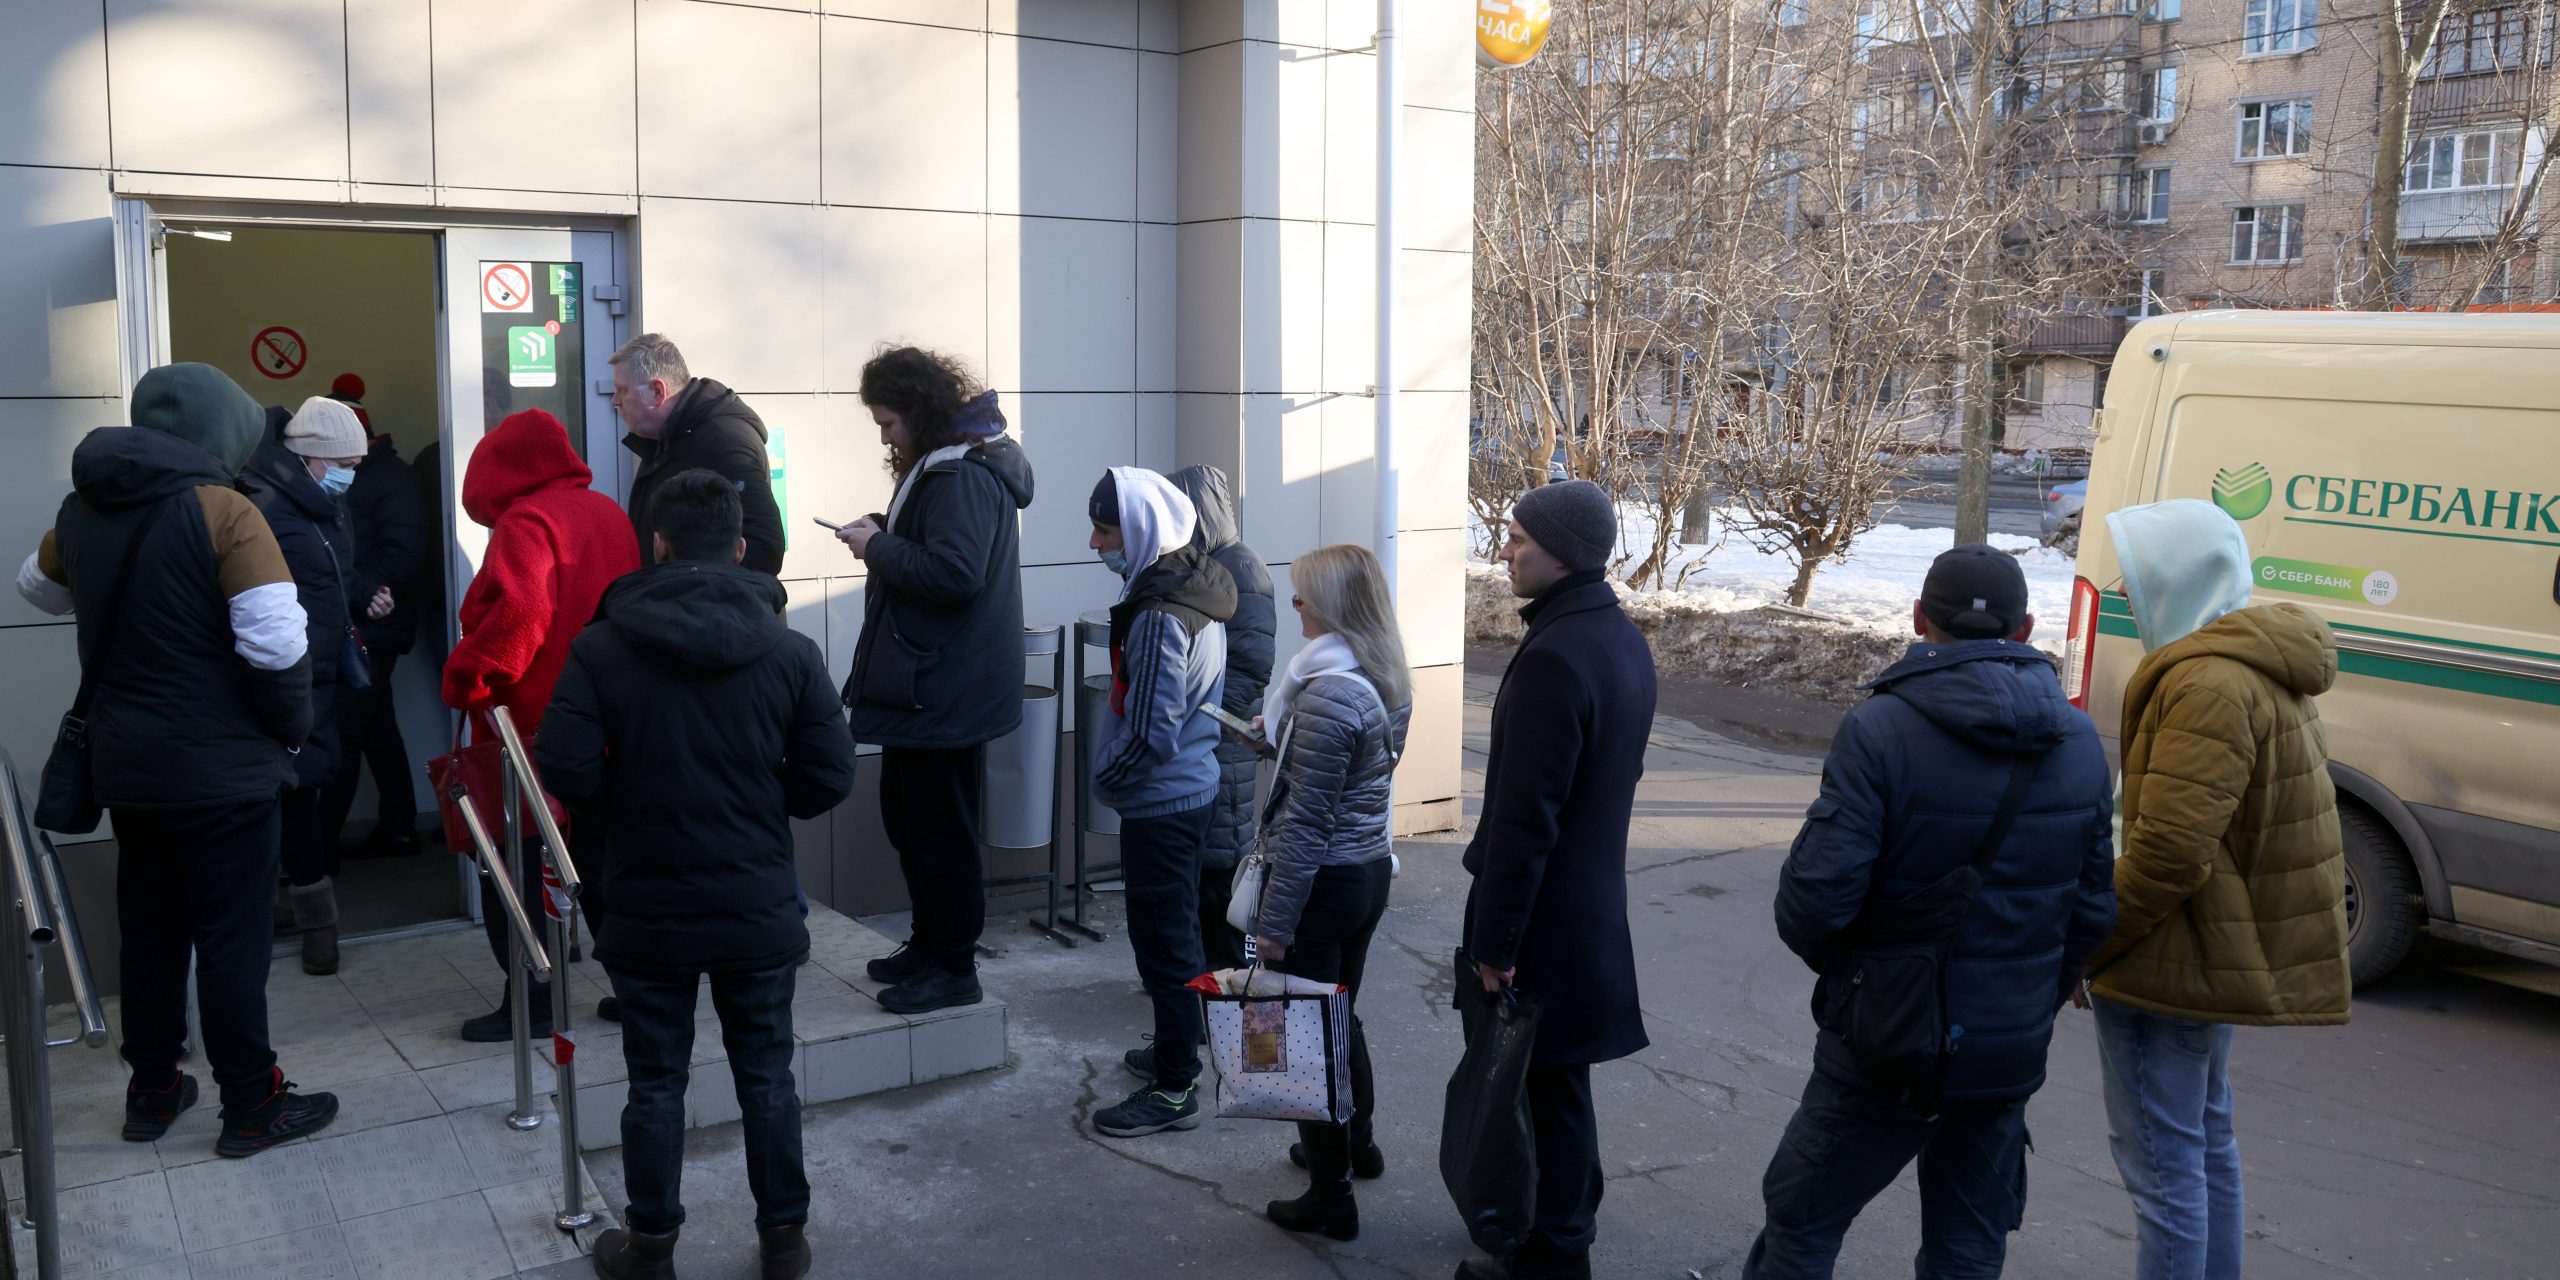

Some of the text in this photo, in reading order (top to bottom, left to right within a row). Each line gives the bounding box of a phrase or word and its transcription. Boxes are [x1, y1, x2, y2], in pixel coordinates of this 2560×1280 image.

[1478, 15, 1531, 46] ЧАСА
[550, 324, 555, 332] 1
[2285, 474, 2560, 534] СБЕРБАНК
[2279, 570, 2352, 589] СБЕР БАНК
[2373, 580, 2390, 590] 180
[2370, 588, 2388, 596] лет
